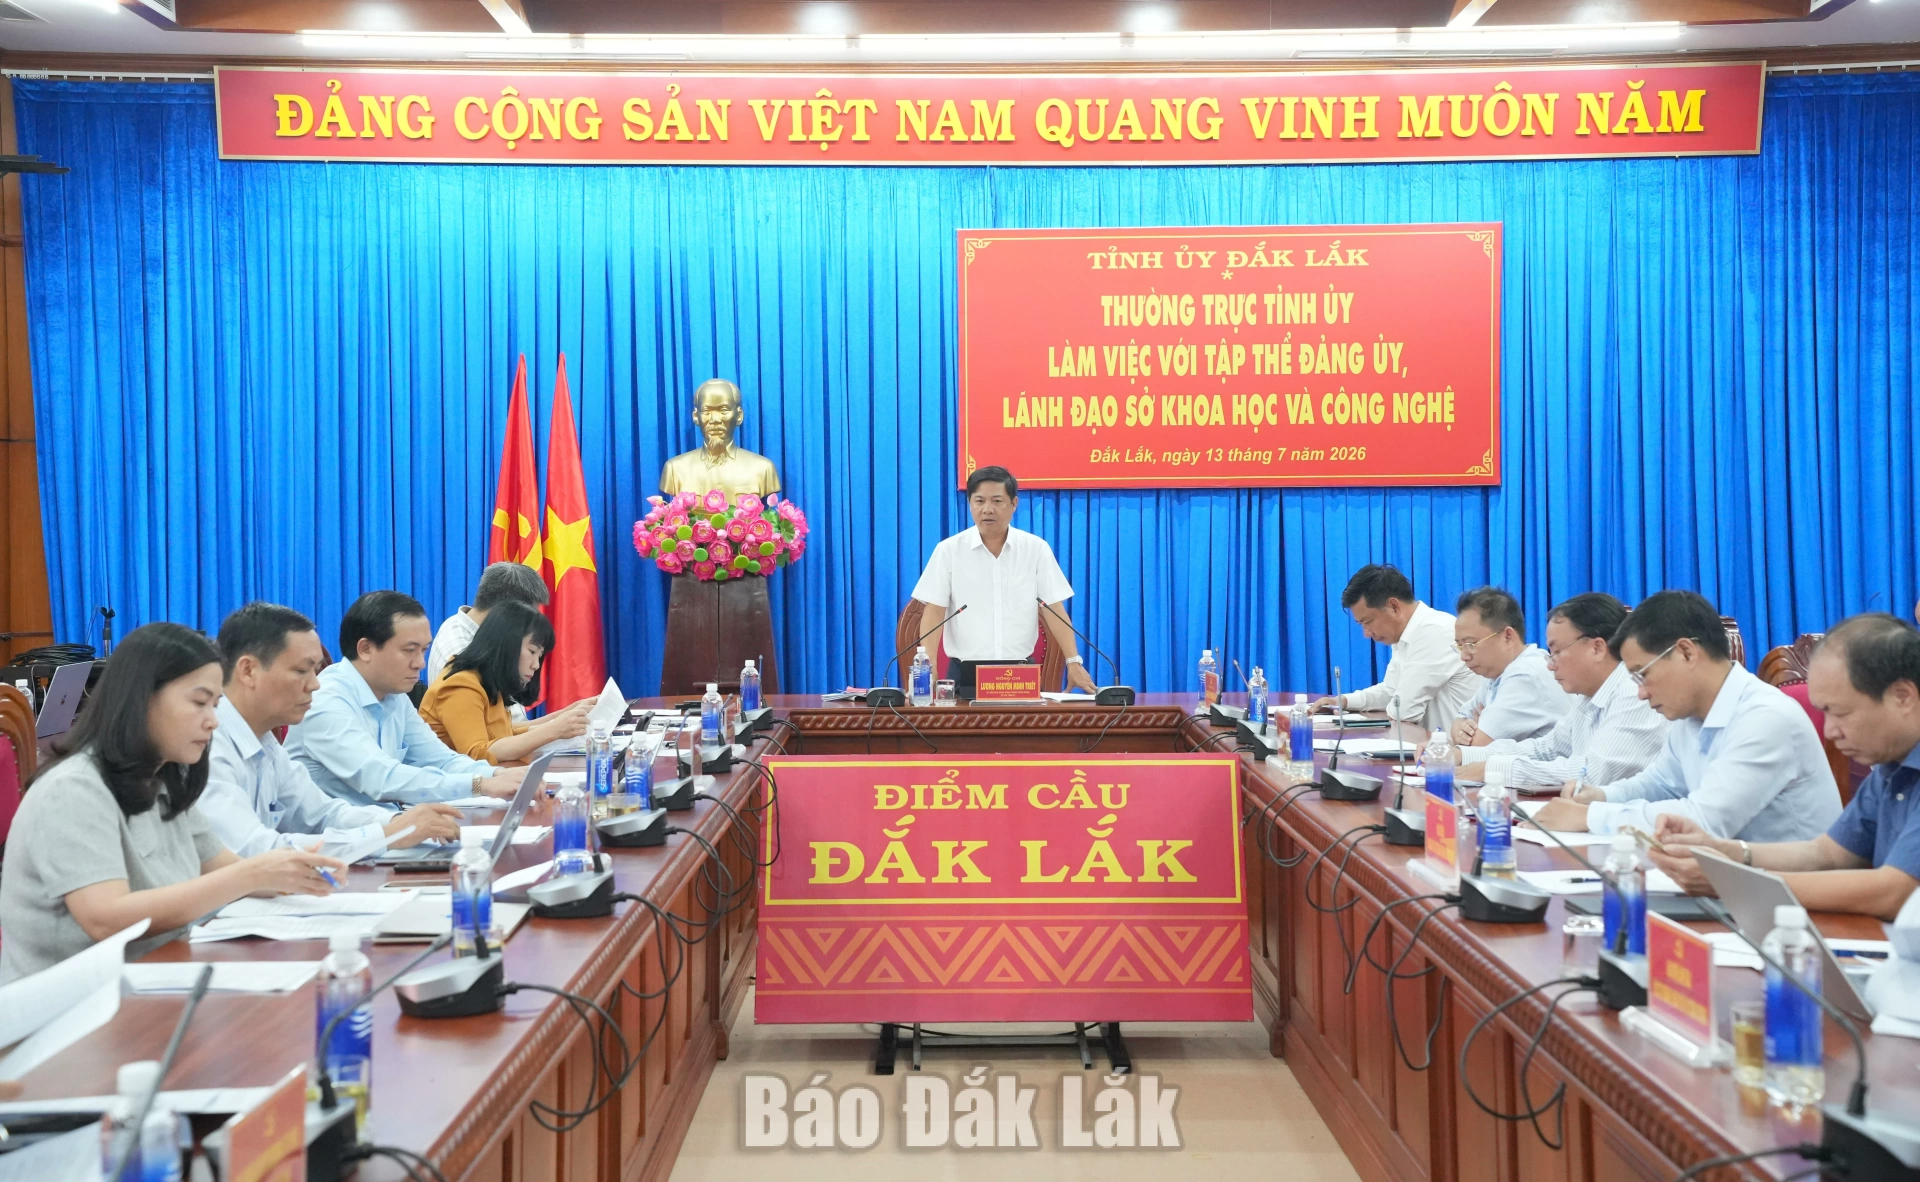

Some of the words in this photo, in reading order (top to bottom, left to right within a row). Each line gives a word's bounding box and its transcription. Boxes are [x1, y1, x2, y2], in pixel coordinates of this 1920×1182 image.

[273, 79, 436, 139] ĐẢNG
[453, 85, 603, 150] CỘNG
[621, 83, 731, 142] SẢN
[748, 87, 878, 152] VIỆT
[895, 98, 1016, 142] NAM
[1034, 97, 1224, 149] QUANG
[1240, 95, 1380, 140] VINH
[1397, 83, 1559, 138] MUÔN
[1574, 79, 1706, 135] NĂM
[1087, 245, 1164, 270] TỈNH
[1174, 244, 1217, 269] ỦY
[1226, 241, 1295, 268] ĐẮK
[1304, 240, 1369, 267] LẮK
[1100, 286, 1196, 327] THƯỜNG
[1202, 292, 1257, 334] TRỰC
[1263, 284, 1317, 325] TỈNH
[1323, 283, 1355, 325] ỦY
[1048, 339, 1097, 378] LÀM
[1103, 338, 1151, 385] VIỆC
[1157, 337, 1197, 377] VỚI
[1204, 338, 1246, 384] TẬP
[1252, 331, 1292, 375] THỂ
[1298, 334, 1365, 375] ĐẢNG
[1373, 333, 1408, 379] ỦY,
[1070, 395, 1119, 435] ĐẠO
[1125, 386, 1156, 427] SỞ
[1161, 394, 1226, 426] KHOA
[1232, 393, 1278, 434] HỌC
[1285, 387, 1315, 425] VÀ
[1321, 386, 1386, 425] CÔNG
[1393, 385, 1455, 432] NGHỆ
[1090, 446, 1121, 463] Đắk
[1125, 446, 1157, 465] Lắk,
[1162, 448, 1201, 466] ngày
[1206, 448, 1224, 462] 13
[1228, 447, 1273, 465] tháng
[1278, 448, 1287, 461] 7
[1291, 447, 1325, 461] năm
[1329, 447, 1367, 461] 2026
[873, 769, 1009, 810] ĐIỂM
[1027, 769, 1131, 810] CẦU
[808, 814, 992, 884] ĐẮK
[1019, 813, 1198, 883] LẮK
